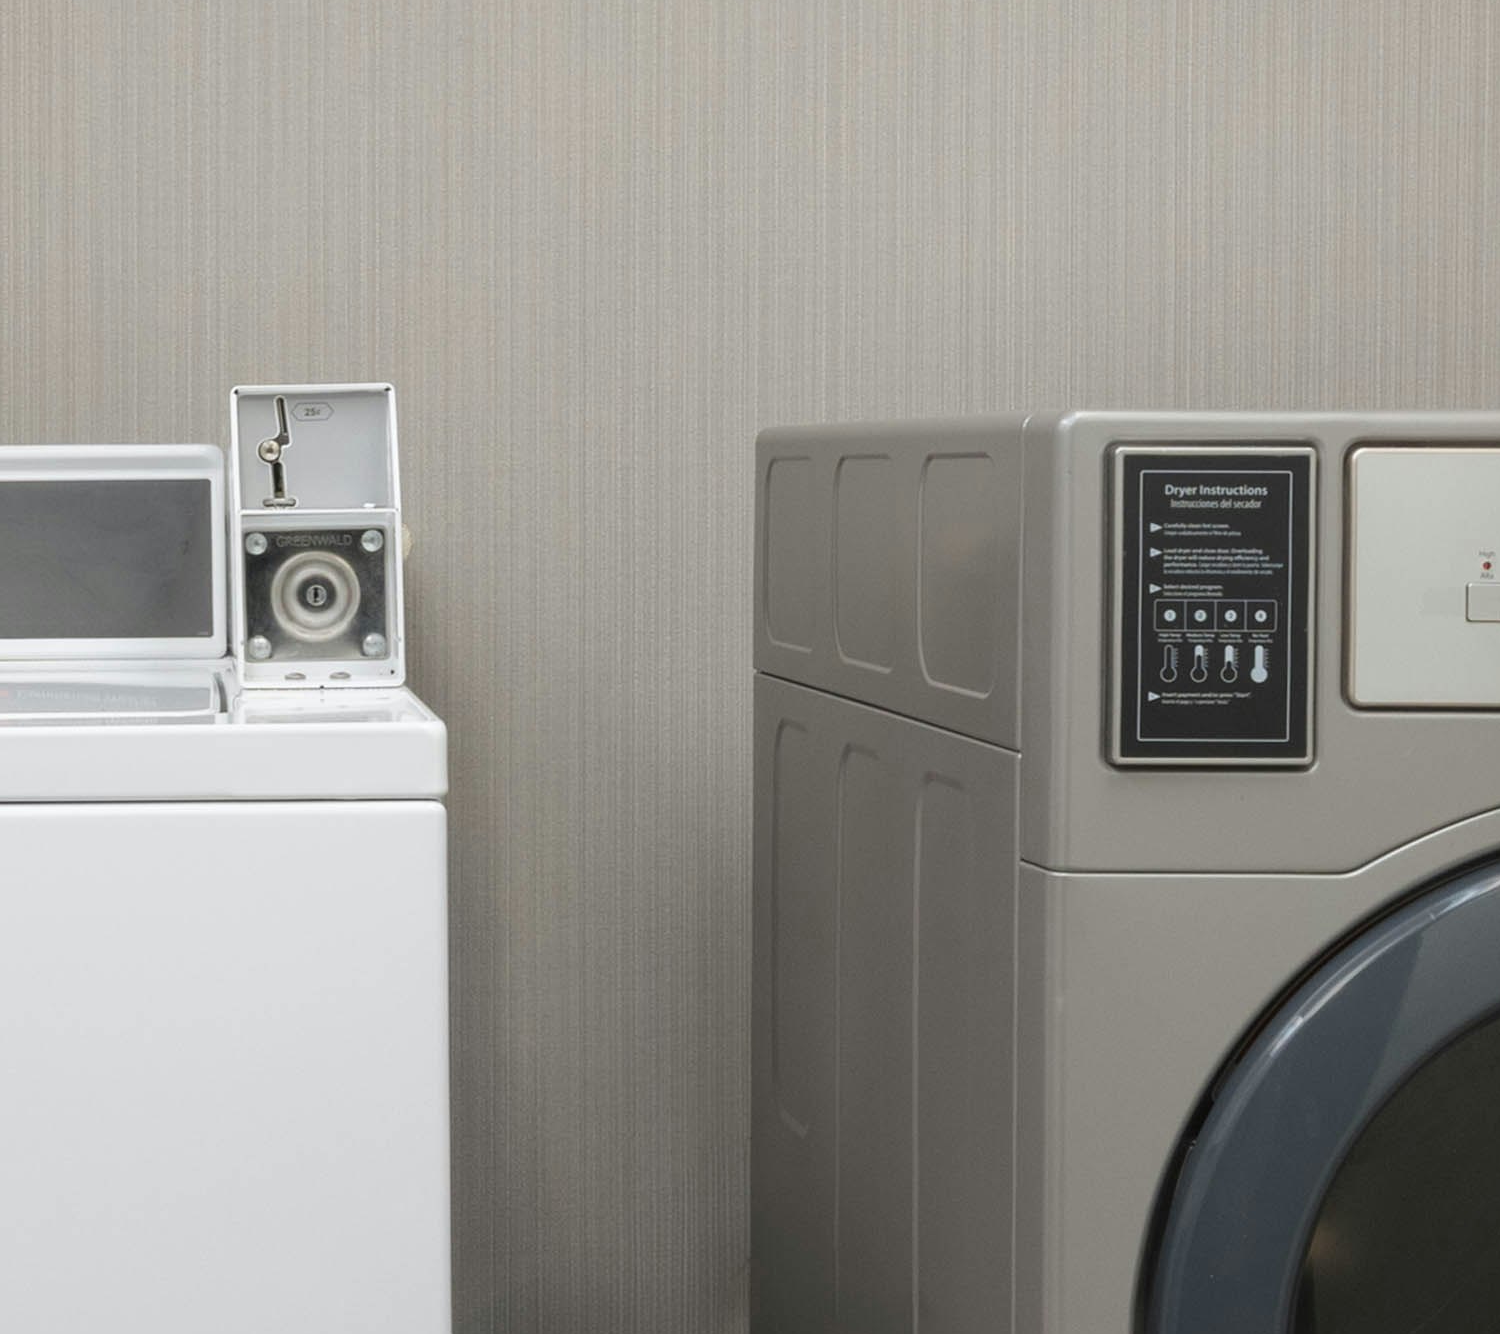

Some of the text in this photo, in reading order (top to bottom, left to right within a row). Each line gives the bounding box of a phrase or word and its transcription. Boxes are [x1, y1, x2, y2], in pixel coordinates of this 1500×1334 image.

[1164, 484, 1268, 498] Dryer Instructions
[1170, 498, 1262, 509] Instrucciones del secador
[275, 534, 353, 548] GREENWALD
